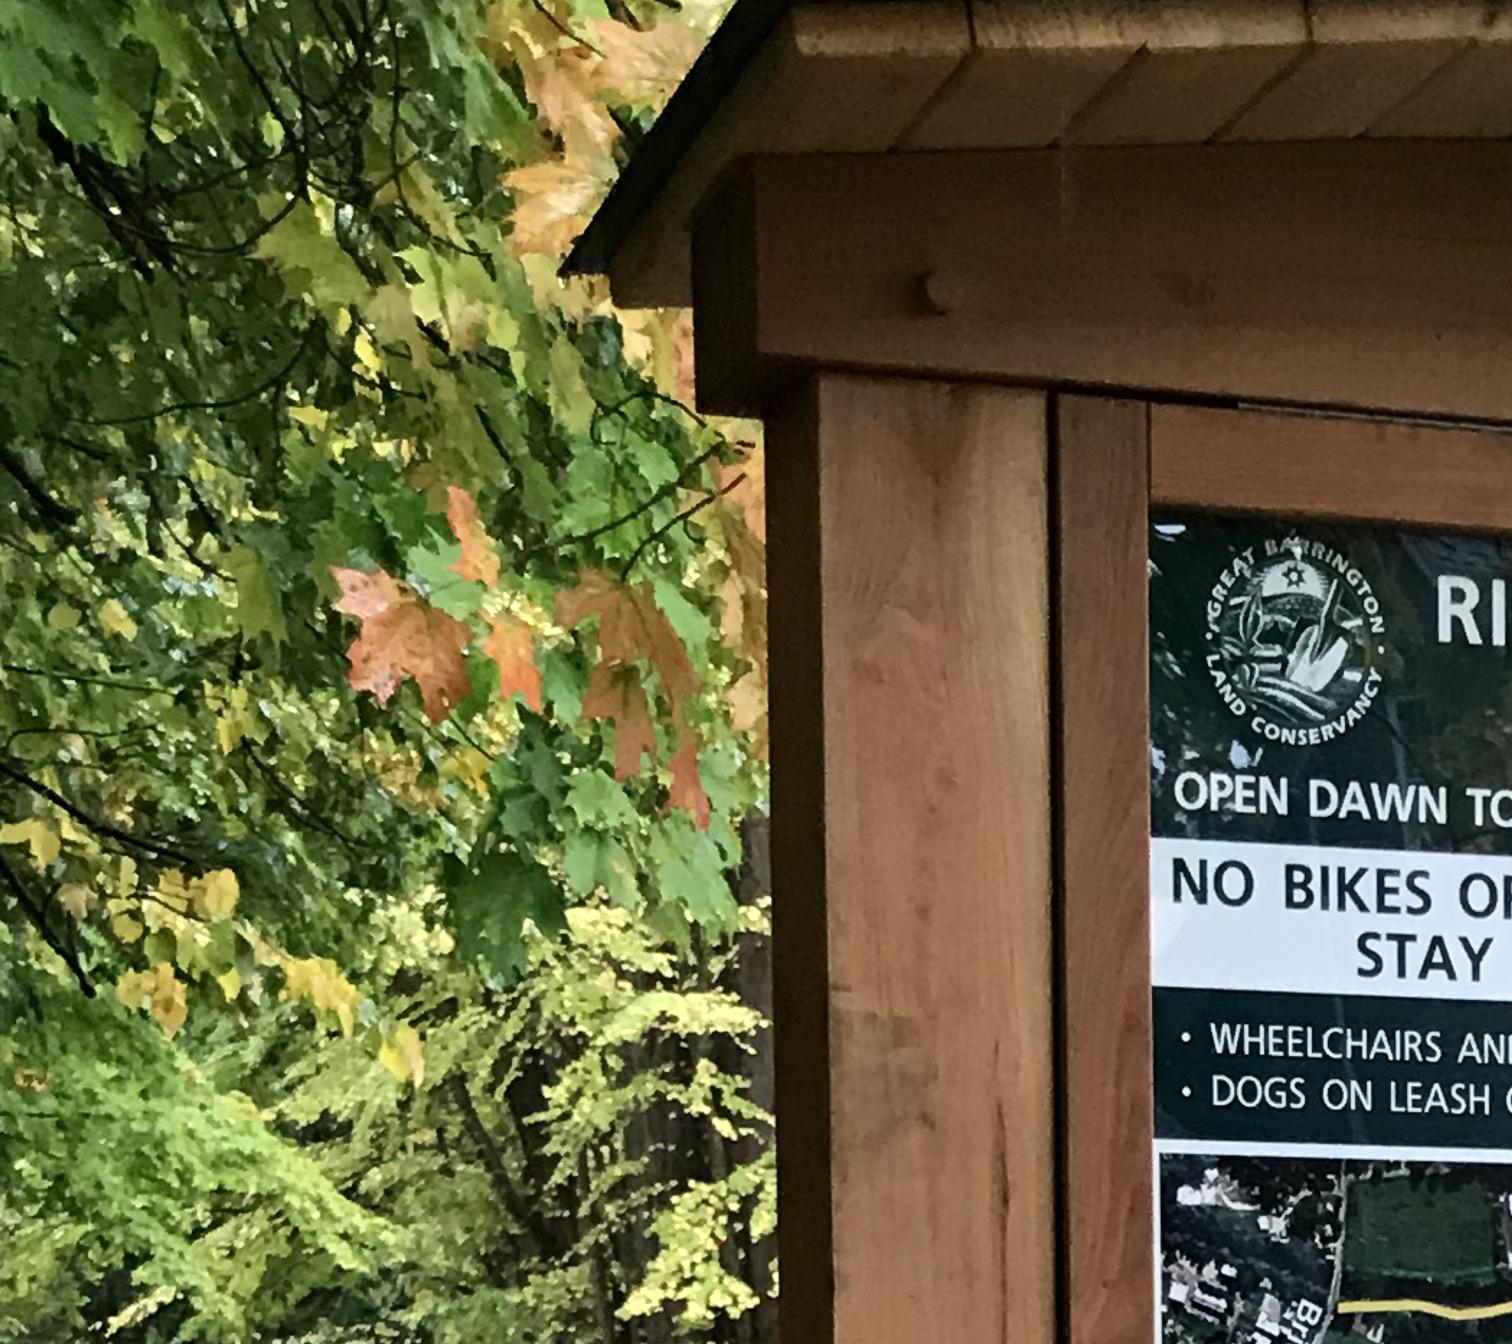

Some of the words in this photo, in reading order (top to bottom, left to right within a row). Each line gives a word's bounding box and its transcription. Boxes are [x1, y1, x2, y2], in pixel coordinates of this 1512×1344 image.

[1207, 547, 1255, 619] GREAT
[1206, 653, 1247, 716] LAND
[1251, 666, 1382, 746] CONSERVANCY
[1173, 772, 1289, 817] OPEN
[1309, 779, 1448, 825] DAWN
[1172, 858, 1254, 907] NO
[1286, 866, 1431, 916] BIKES
[1356, 932, 1492, 983] STAY
[1210, 1023, 1442, 1063] WHEELCHAIRS
[1211, 1075, 1306, 1109] DOGS
[1322, 1079, 1373, 1111] ON
[1389, 1082, 1490, 1117] LEASH
